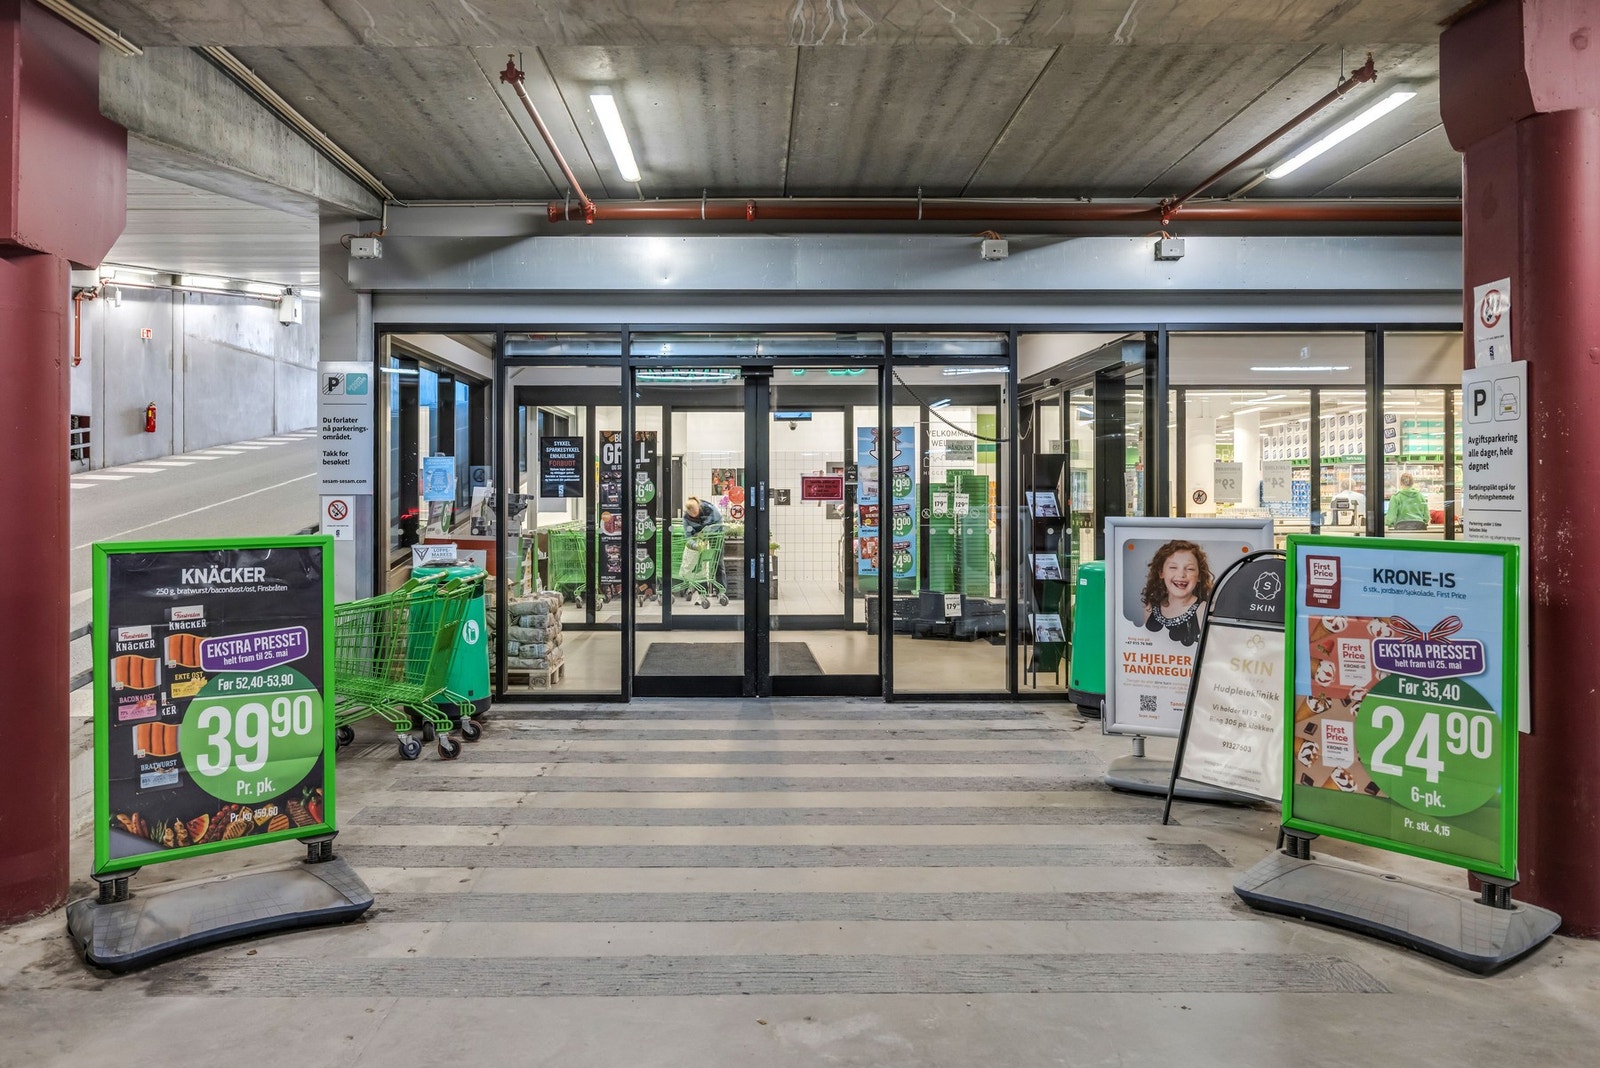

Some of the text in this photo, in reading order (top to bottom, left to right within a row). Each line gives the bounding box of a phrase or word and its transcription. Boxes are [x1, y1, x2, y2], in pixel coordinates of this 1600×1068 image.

[1474, 389, 1487, 416] P
[332, 425, 369, 433] parkerings-
[1468, 433, 1518, 446] Avgiftsparkering
[1468, 447, 1513, 458] alle dager, hele
[1468, 462, 1489, 472] døgnet
[1468, 484, 1497, 492] Betalingsplikt
[1498, 483, 1508, 492] også
[181, 565, 266, 585] KNÄCKER
[1313, 569, 1334, 577] Price
[1373, 568, 1456, 588] KRONE-IS
[156, 587, 169, 595] 250
[257, 584, 288, 592] Finsbråten
[1451, 592, 1467, 600] Price
[1249, 603, 1275, 613] SKIN
[207, 632, 302, 658] EKSTRA PRESSET
[1342, 643, 1362, 652] First
[223, 656, 237, 665] helt
[238, 655, 255, 663] fram
[264, 651, 275, 659] 25.
[275, 648, 288, 658] mai
[1342, 651, 1365, 660] Price
[1378, 643, 1477, 660] EKSTRA PRESSET
[1123, 652, 1192, 666] VI HJELPER
[1395, 659, 1462, 670] helt fram til 25. mai
[1230, 657, 1274, 677] SKIN
[218, 674, 294, 691] Før 52,40-53,90
[1213, 683, 1280, 702] Hudpleieklinikk
[1398, 677, 1460, 701] Før 35,40
[1219, 705, 1240, 714] holder
[1224, 718, 1237, 726] 305
[1237, 721, 1247, 729] på
[1325, 724, 1345, 734] First
[1326, 732, 1348, 742] Price
[140, 759, 177, 771] BRATWURST
[236, 777, 276, 796] Pr. pk.
[1411, 786, 1446, 808] 6-pk.
[242, 812, 252, 822] kg
[254, 806, 278, 818] 159,60
[1404, 817, 1450, 836] Pr. stk. 4,15
